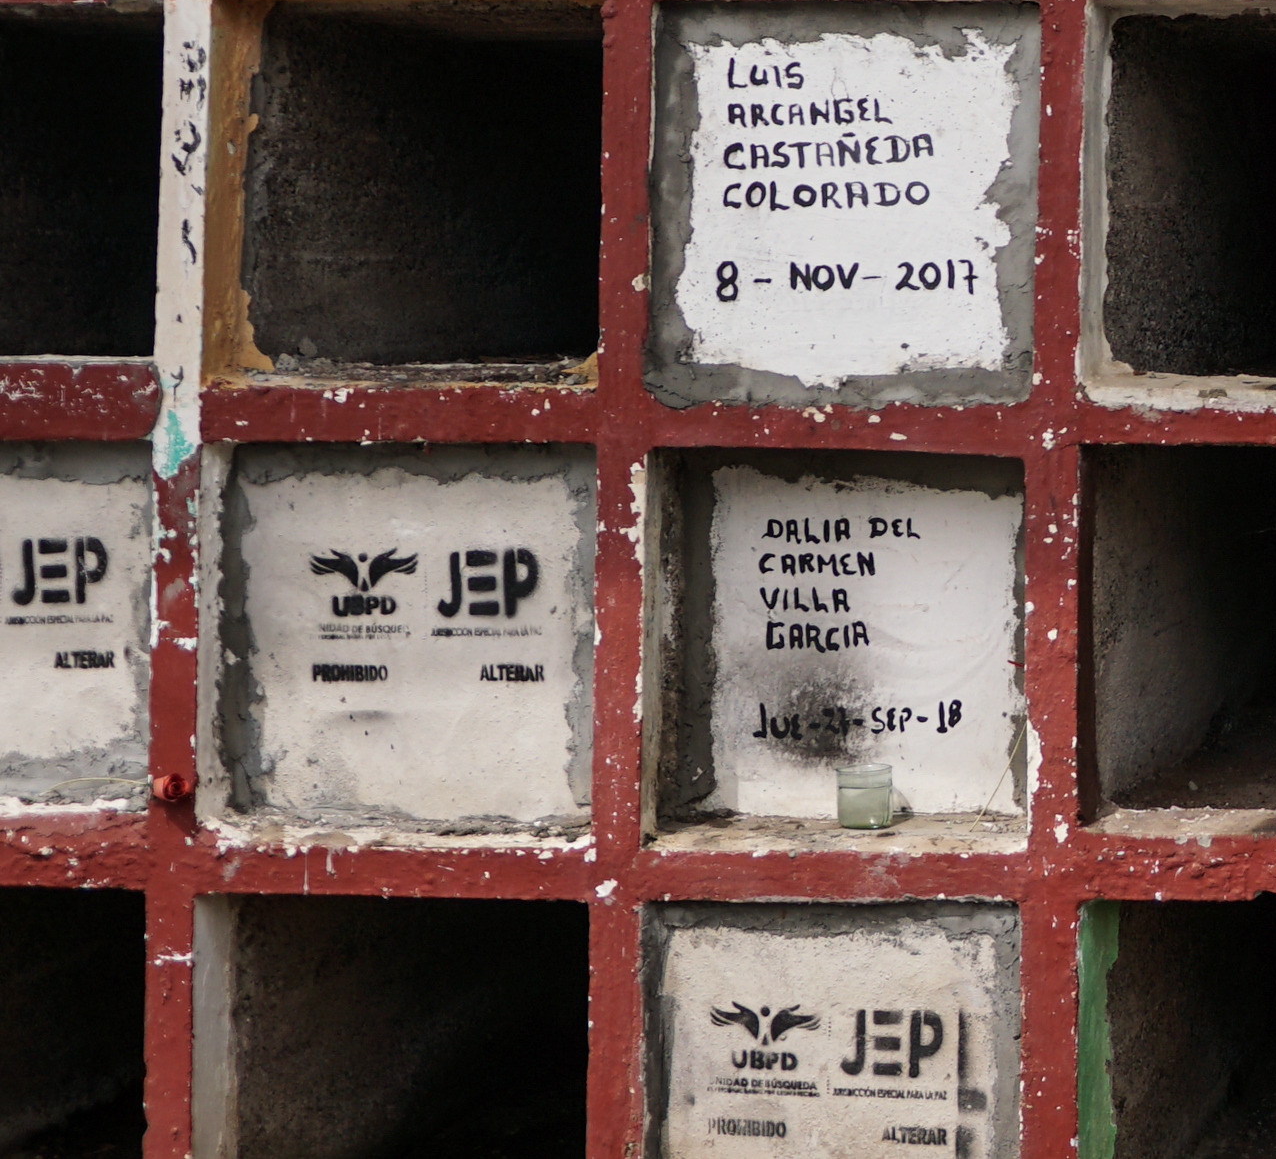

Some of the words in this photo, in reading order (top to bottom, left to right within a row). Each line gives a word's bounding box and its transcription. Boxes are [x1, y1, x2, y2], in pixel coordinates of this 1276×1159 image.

[727, 57, 805, 90] LUIS
[727, 97, 893, 128] ARCANGEL
[722, 131, 934, 171] CASTAÑEDA
[722, 180, 930, 212] COLORADO
[761, 517, 851, 545] DALIA
[867, 515, 921, 540] DEL
[11, 536, 109, 607] JEP
[758, 551, 876, 577] CARMEN
[436, 548, 539, 618] JEP
[759, 586, 851, 614] VILLA
[765, 620, 870, 654] GARCIA
[312, 664, 389, 683] PROHIBIDO
[480, 664, 545, 682] ALTERAR
[840, 1009, 943, 1078] JEP
[731, 1050, 799, 1070] UBPD
